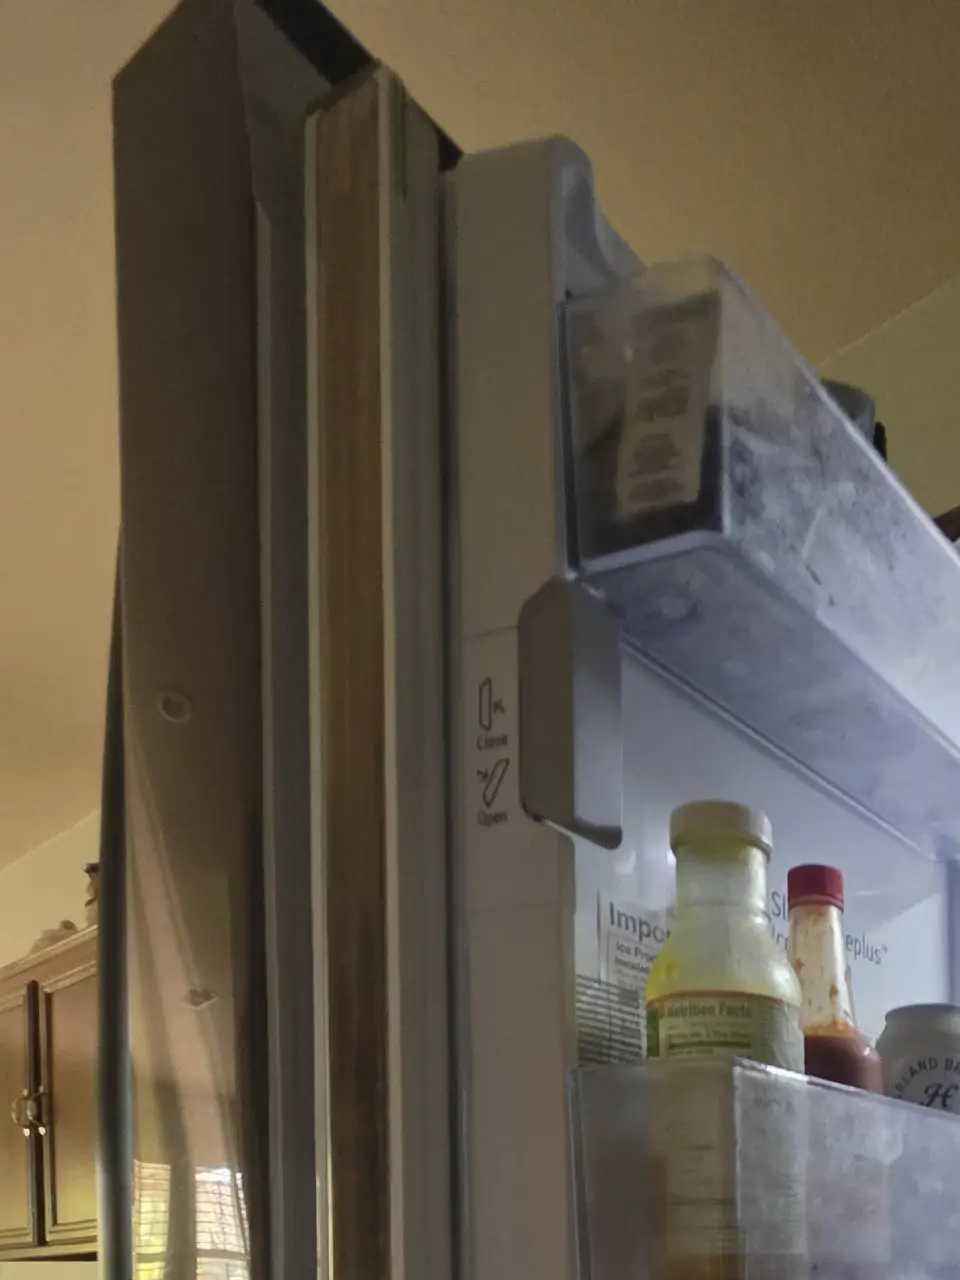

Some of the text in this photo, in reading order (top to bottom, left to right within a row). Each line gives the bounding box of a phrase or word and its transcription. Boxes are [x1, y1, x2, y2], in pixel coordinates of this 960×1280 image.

[477, 810, 508, 828] Open
[771, 890, 882, 965] Sl eplus
